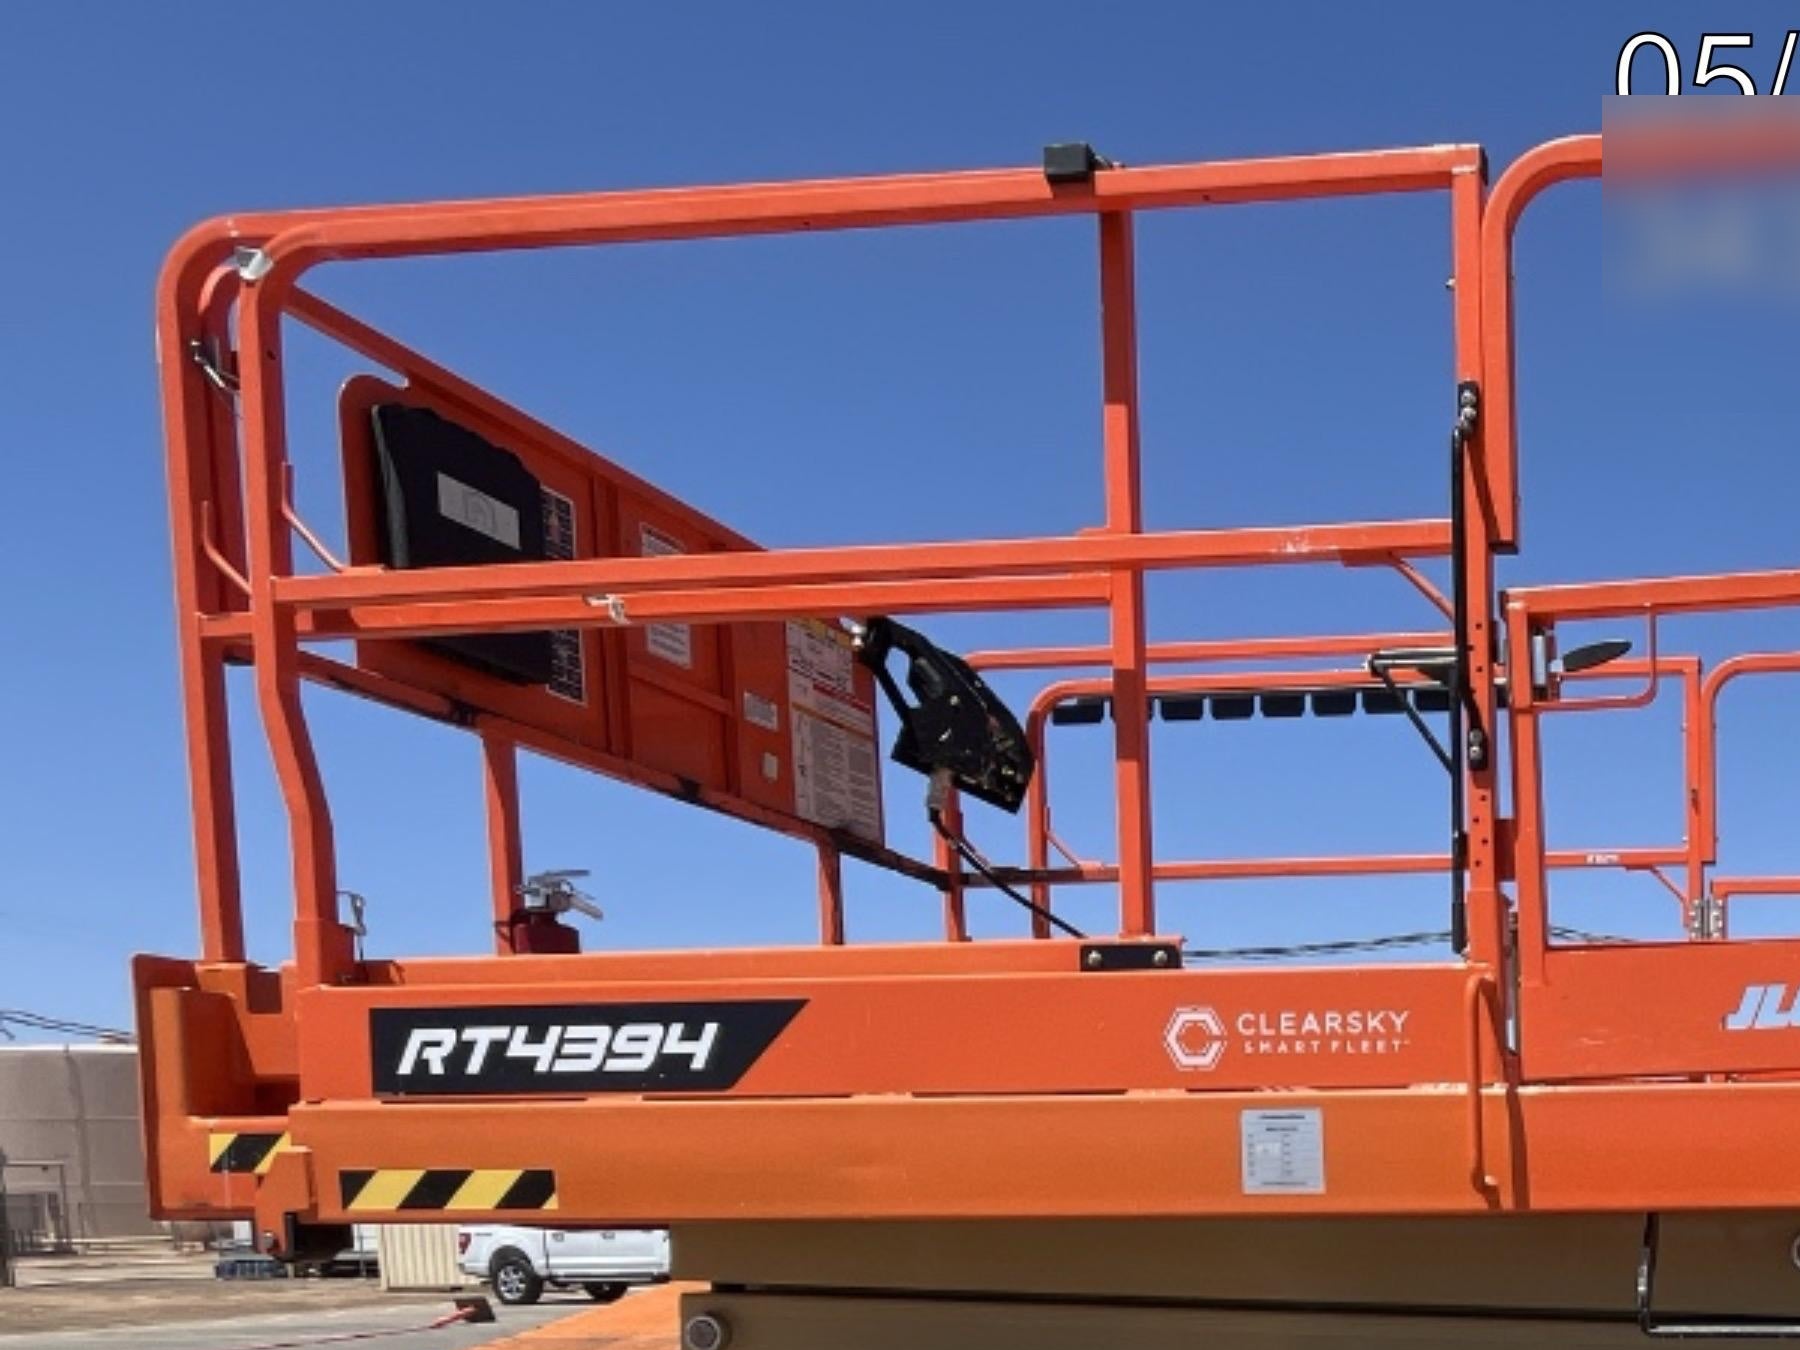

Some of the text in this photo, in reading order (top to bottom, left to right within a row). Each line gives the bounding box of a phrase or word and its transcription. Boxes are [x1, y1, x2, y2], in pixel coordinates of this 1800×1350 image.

[1237, 1010, 1411, 1036] CLEARSKY
[396, 1022, 719, 1075] RT4394
[1244, 1040, 1321, 1054] SMART
